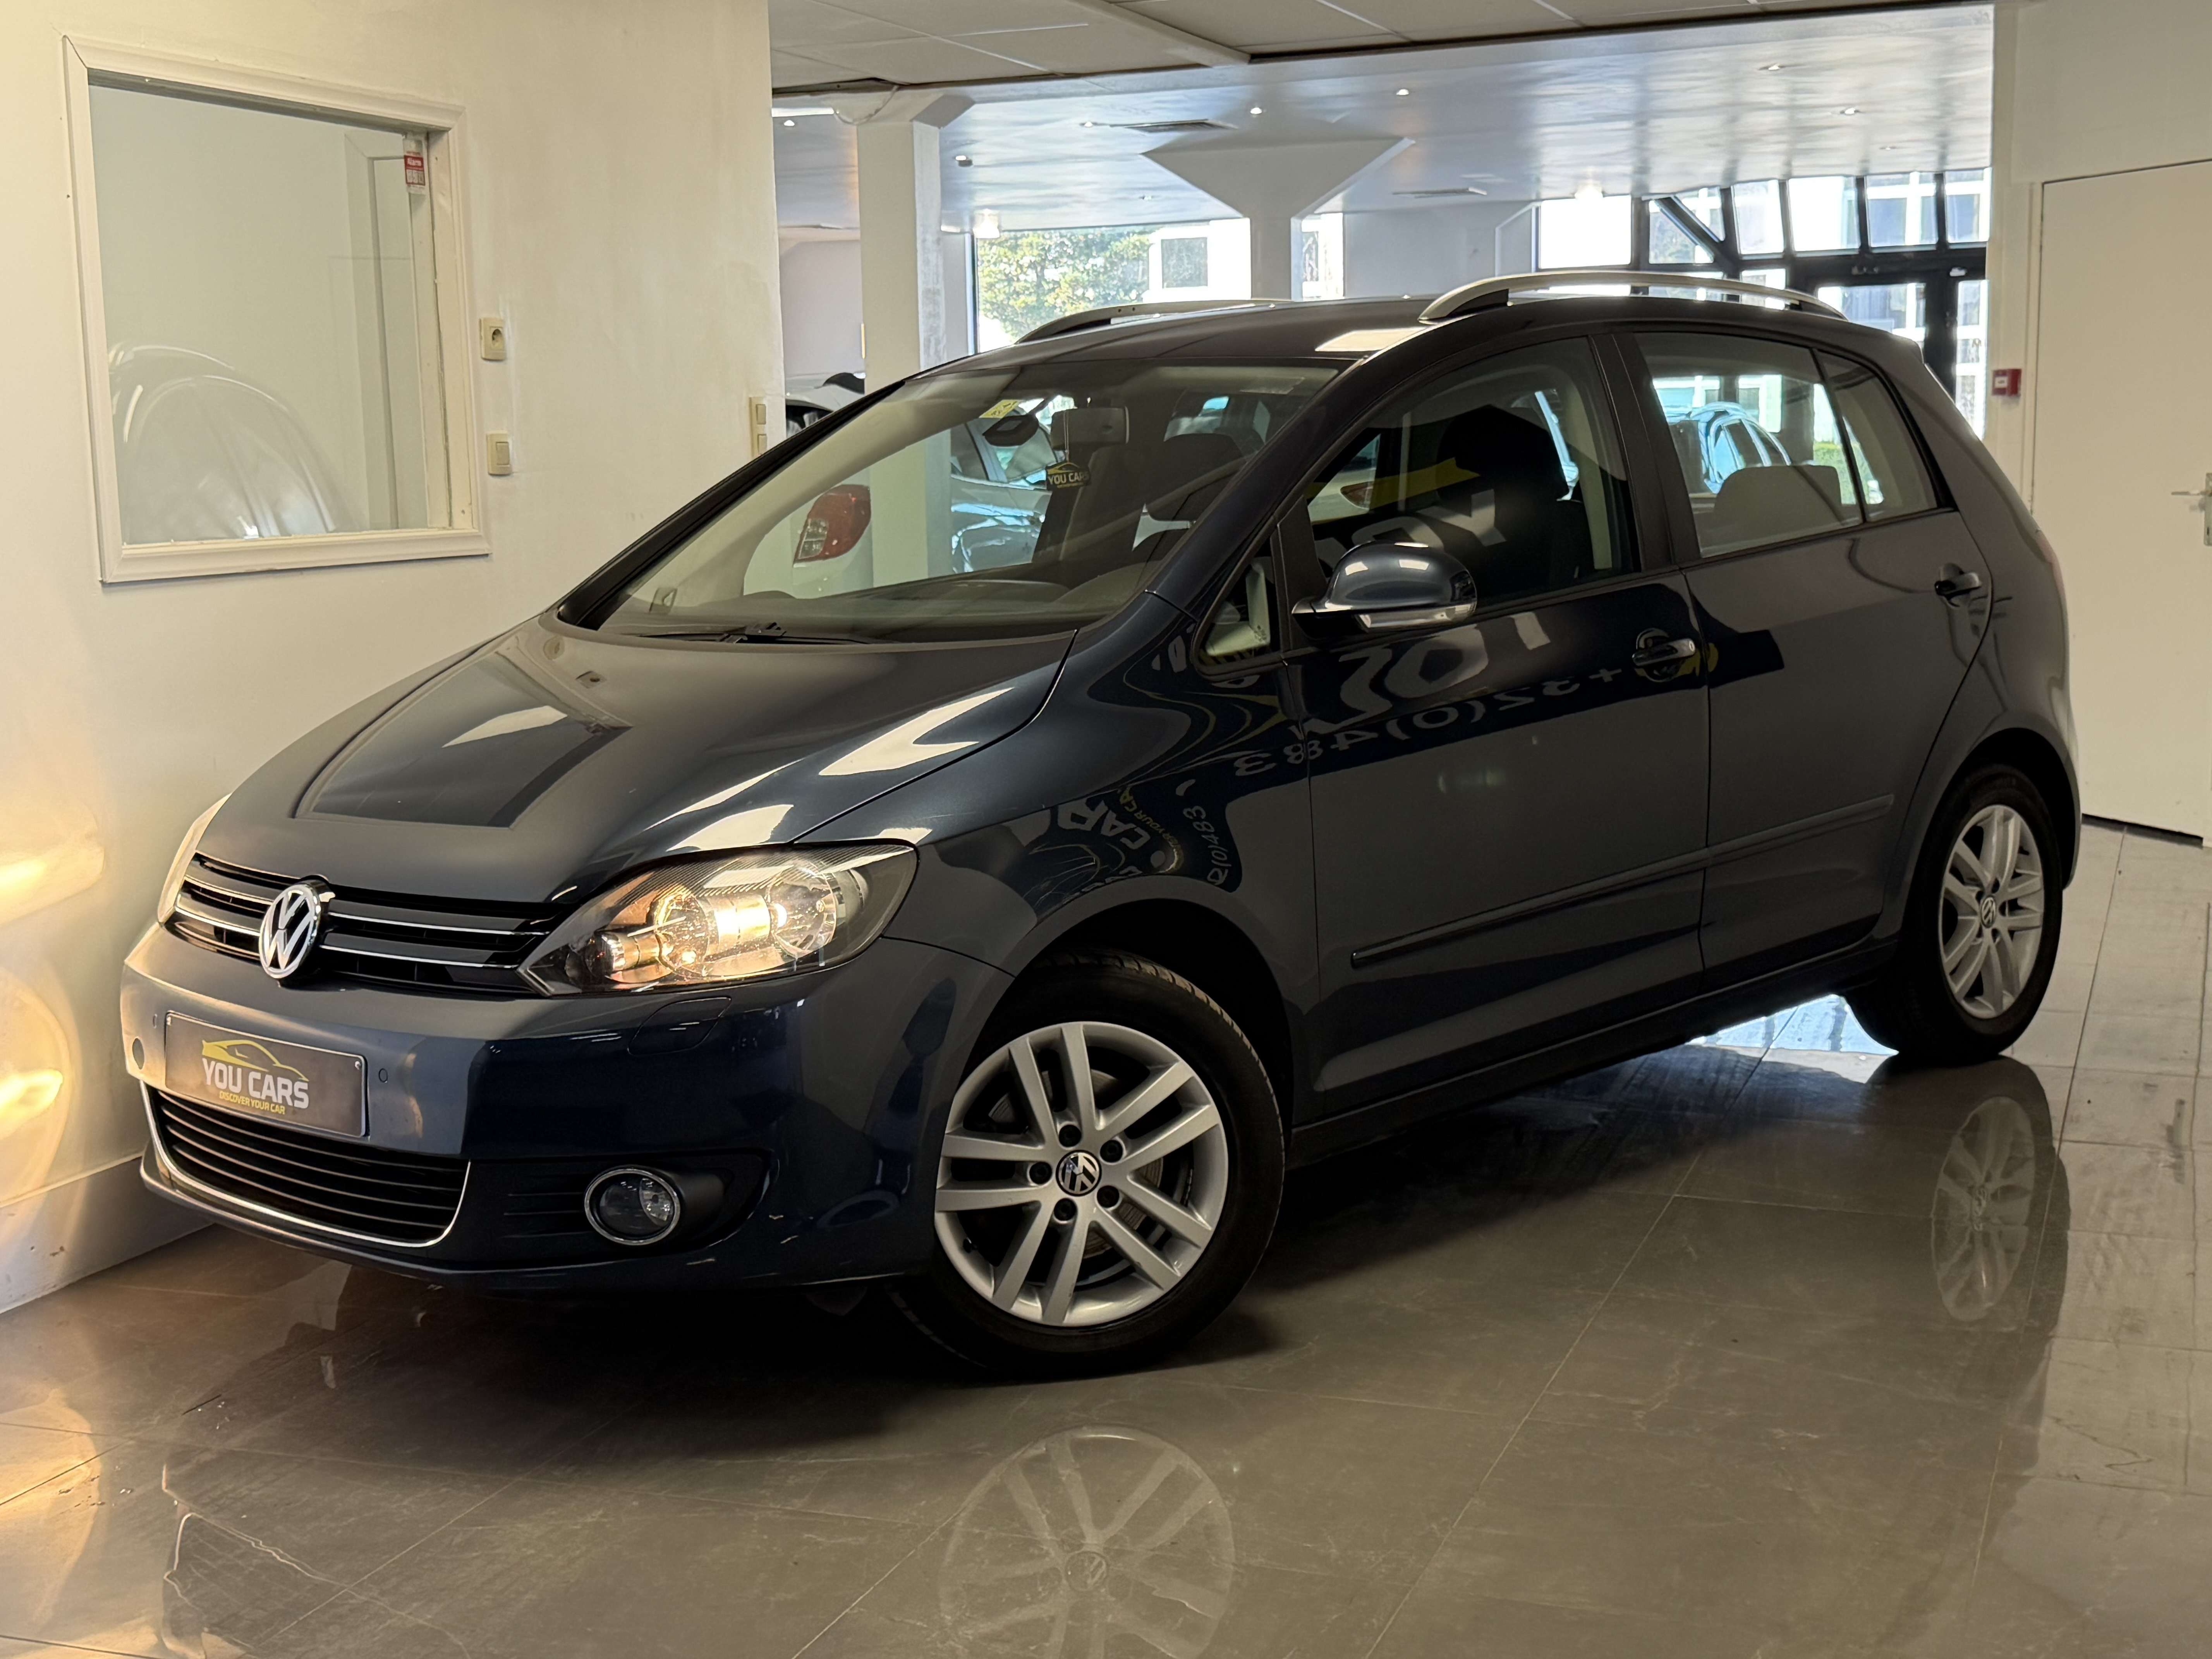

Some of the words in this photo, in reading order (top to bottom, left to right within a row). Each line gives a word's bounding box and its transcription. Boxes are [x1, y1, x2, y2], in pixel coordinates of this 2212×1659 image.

[1048, 473, 1067, 484] YOU
[202, 1058, 242, 1094] YOU
[248, 1071, 309, 1109] CARS
[219, 1090, 250, 1107] DISCOVER
[251, 1099, 270, 1111] YOUR
[270, 1103, 285, 1115] CAR
